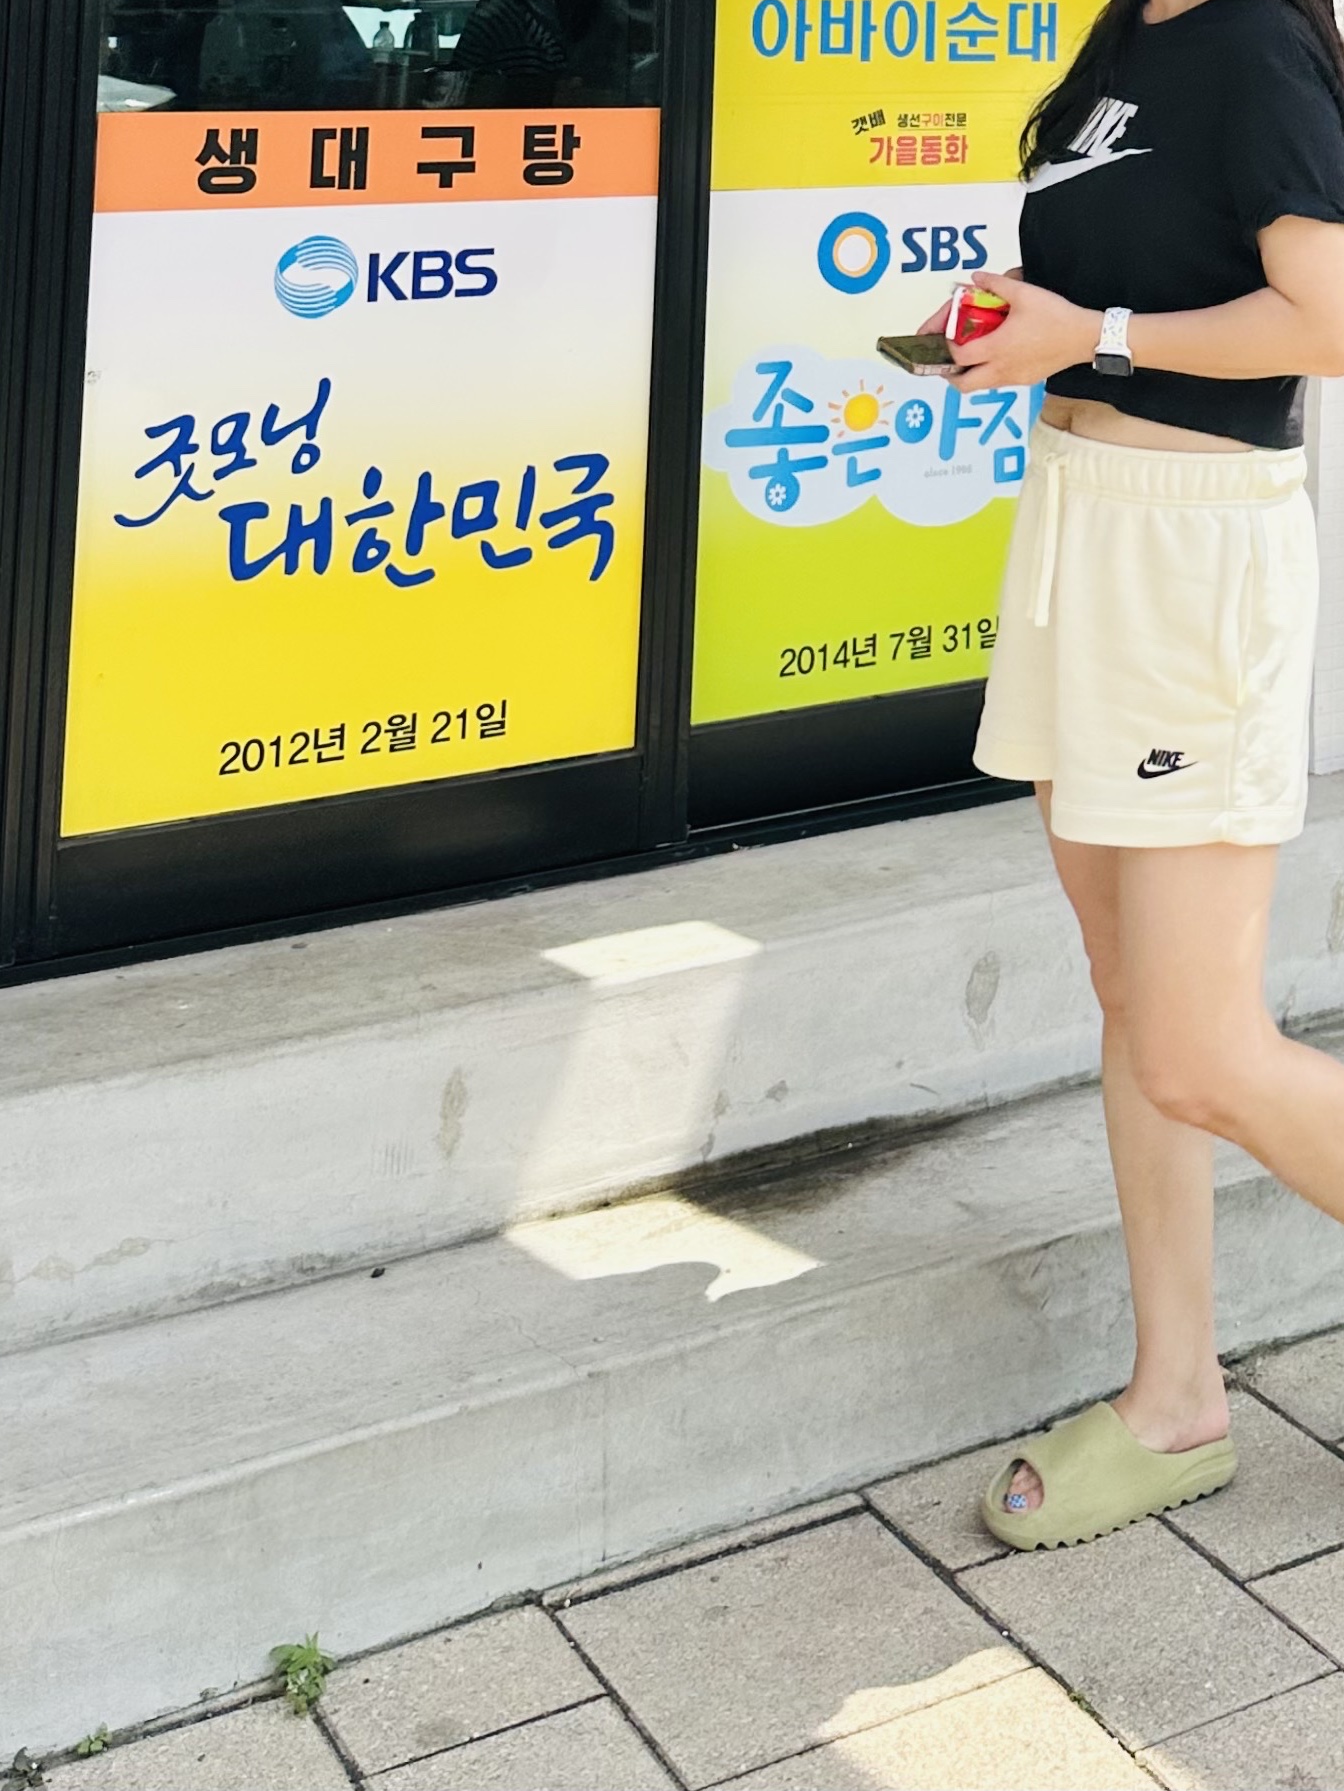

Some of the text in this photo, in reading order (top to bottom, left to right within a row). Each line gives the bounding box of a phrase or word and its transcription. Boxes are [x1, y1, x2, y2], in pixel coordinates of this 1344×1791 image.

[851, 108, 886, 136] 갯배
[897, 112, 967, 128] 생선구이전문
[869, 134, 968, 166] 가을동화
[367, 247, 499, 303] KBS
[900, 224, 989, 274] SBS
[113, 377, 332, 528] 굿모닝
[724, 360, 1046, 513] 좋은아침
[218, 452, 616, 588] 대한민국
[778, 614, 1000, 680] 2014년 7월 31일
[217, 699, 509, 777] 2012년 2월 21일
[1146, 749, 1186, 770] NIKE
